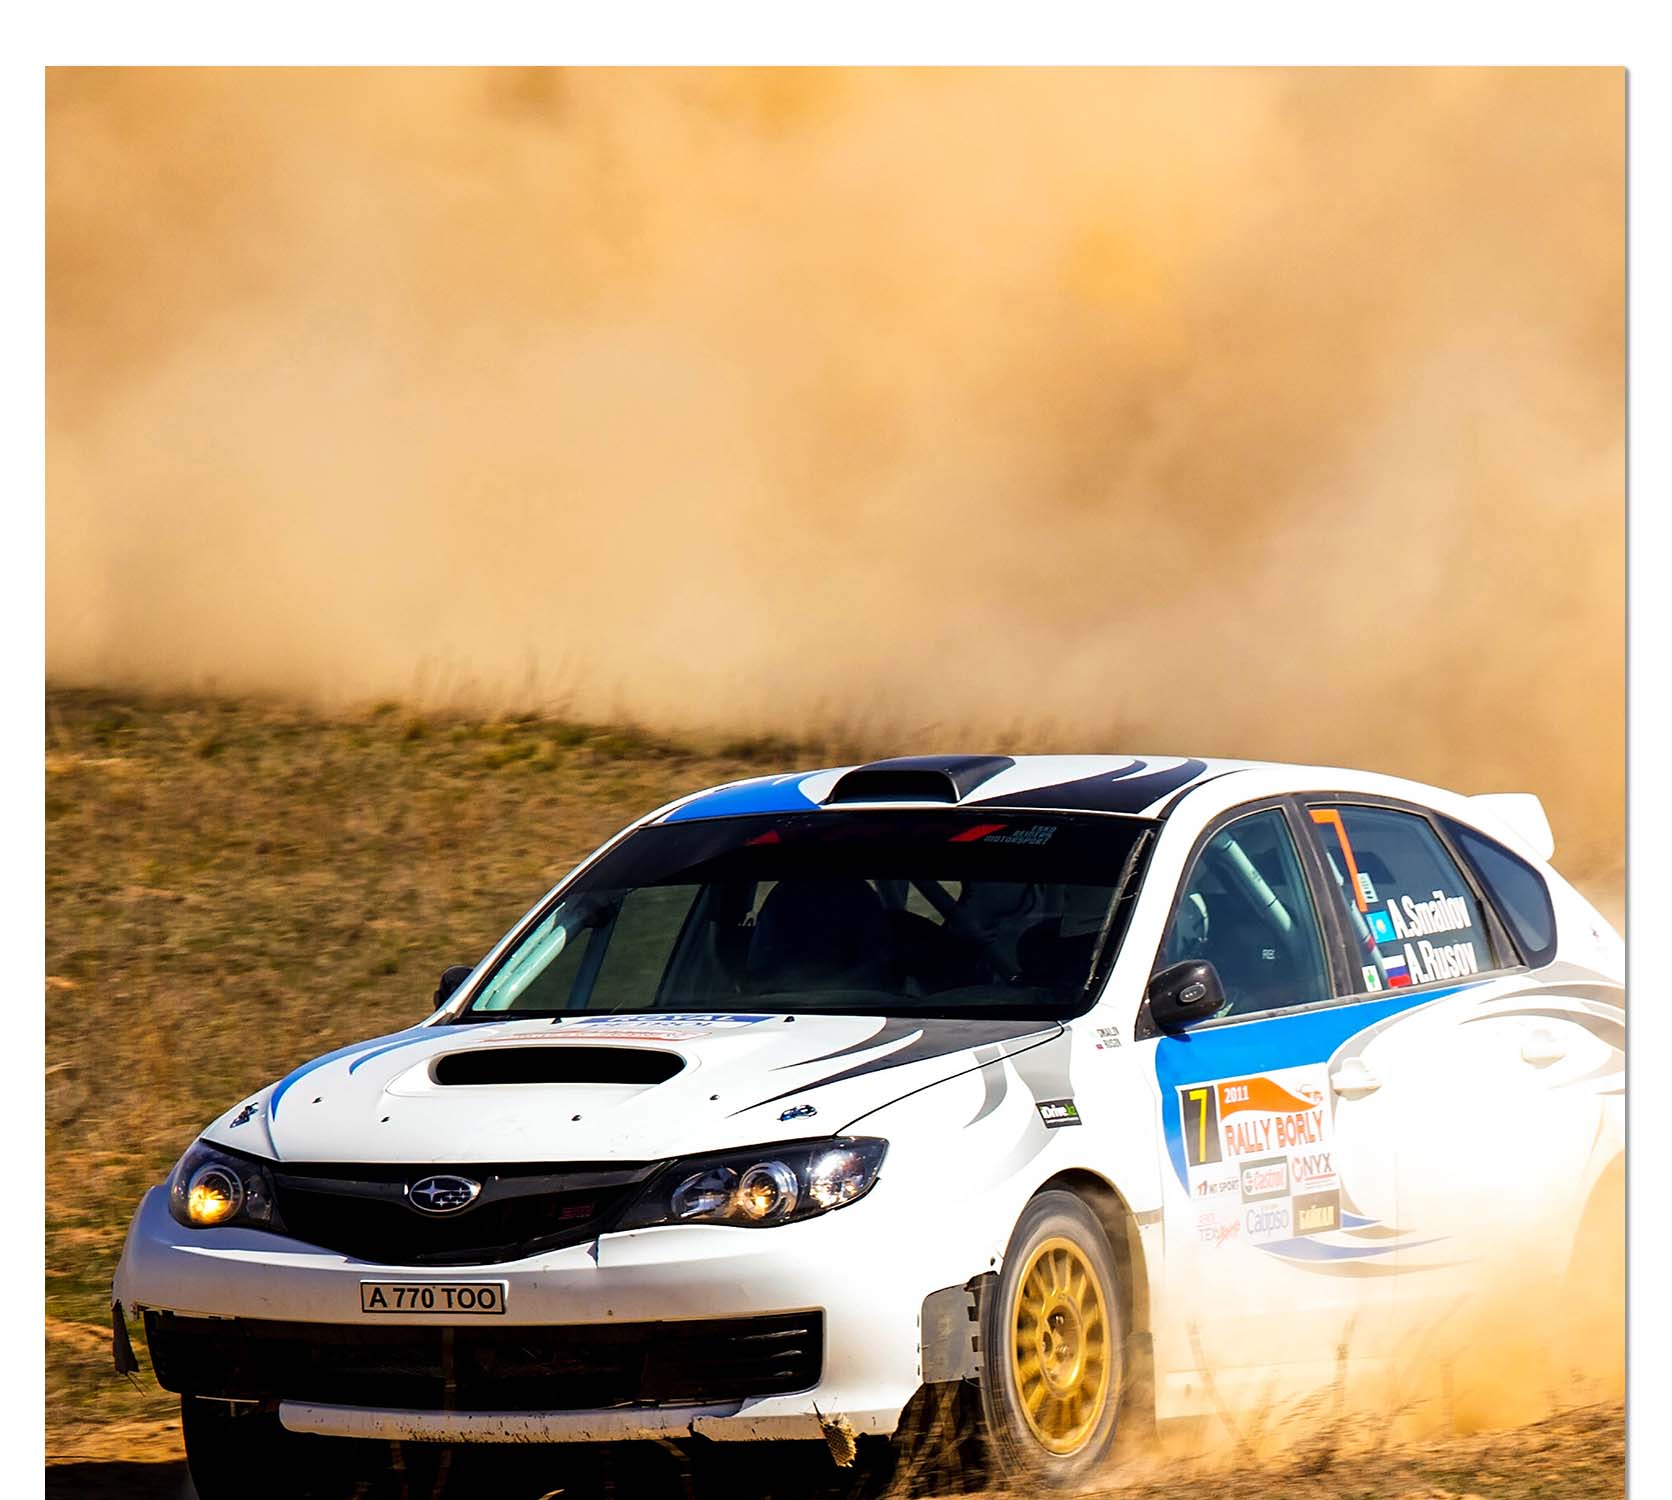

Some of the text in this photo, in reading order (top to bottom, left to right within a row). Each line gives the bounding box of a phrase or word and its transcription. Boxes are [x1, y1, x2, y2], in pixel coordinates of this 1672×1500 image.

[1308, 809, 1368, 912] 7
[1403, 940, 1479, 985] A.Rusov
[1224, 1085, 1249, 1105] 2011
[1189, 1089, 1208, 1163] 7
[1225, 1110, 1324, 1157] RALLY BORLY
[369, 1287, 496, 1310] A 770 TOO
